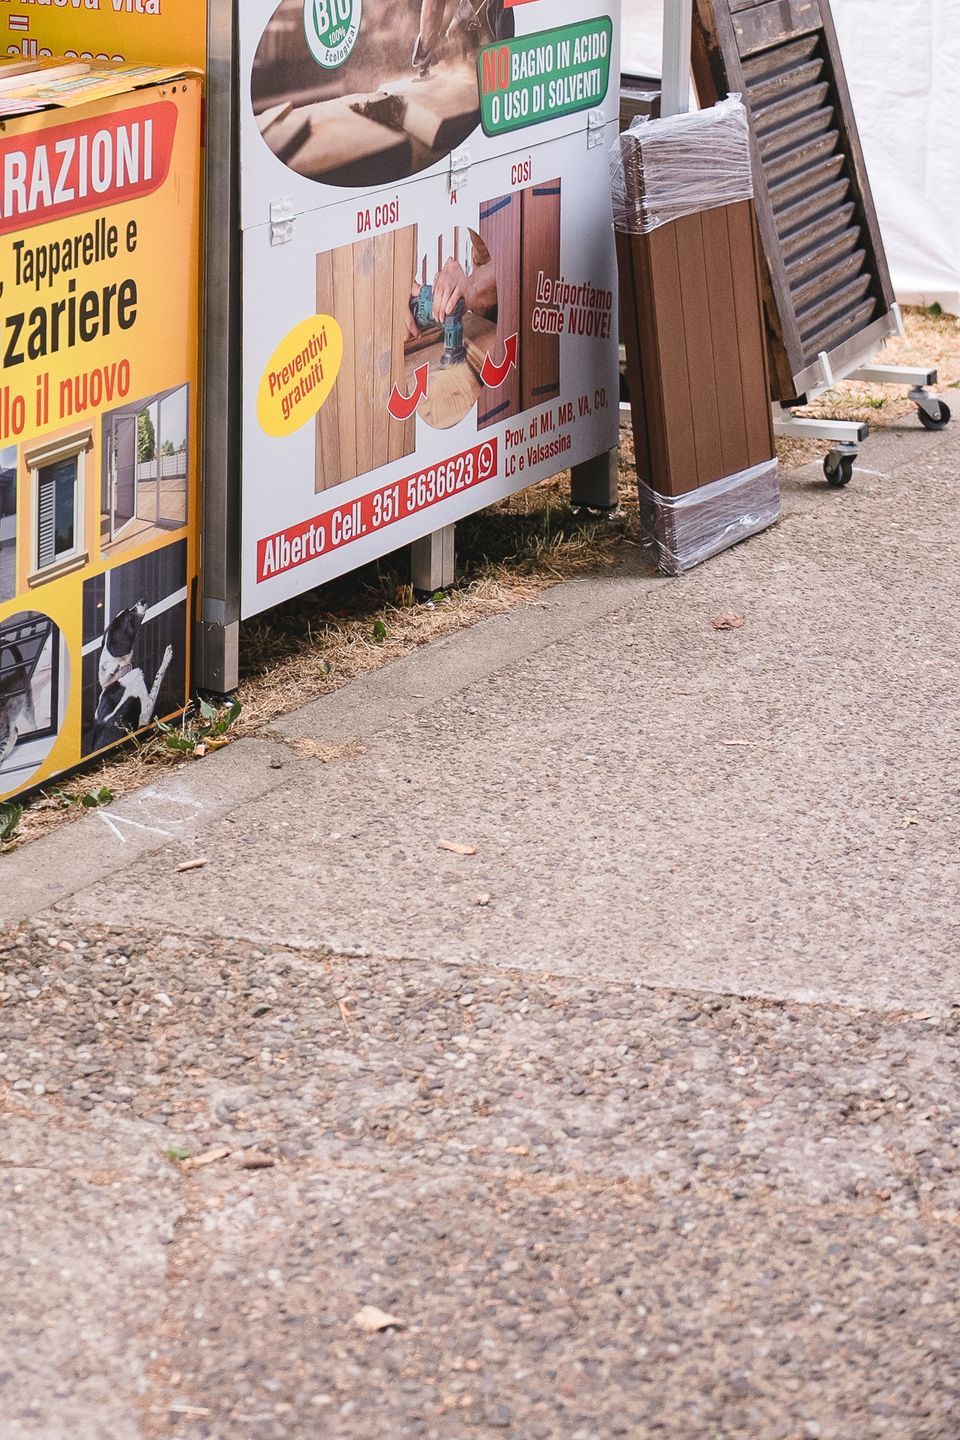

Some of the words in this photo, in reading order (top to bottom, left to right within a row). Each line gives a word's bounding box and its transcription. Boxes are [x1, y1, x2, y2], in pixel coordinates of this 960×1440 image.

[324, 24, 356, 62] Ecological
[328, 25, 346, 46] 100%
[482, 45, 510, 94] NO
[511, 44, 554, 82] BAGNO
[557, 40, 571, 70] IN
[573, 30, 607, 65] ACIDO
[491, 95, 500, 125] O
[504, 83, 529, 121] USO
[532, 82, 545, 112] DI
[548, 67, 601, 109] SOLVENTI
[356, 208, 371, 235] DA
[374, 195, 399, 229] COSÌ
[510, 156, 532, 186] COSÌ
[12, 217, 119, 291] Tapparelle
[126, 219, 138, 253] e
[536, 271, 551, 303] Le
[554, 277, 612, 310] riportiamo
[533, 306, 564, 334] come
[567, 307, 612, 338] NUOVE!
[268, 325, 328, 397] Preventivi
[281, 358, 324, 420] gratuiti
[36, 372, 49, 428] il
[59, 358, 130, 419] nuovo
[504, 427, 527, 450] Prov.
[530, 422, 538, 438] di
[540, 412, 556, 433] MI,
[558, 401, 576, 426] MB,
[578, 394, 592, 417] VA,
[594, 388, 609, 409] CO,
[504, 455, 516, 478] LC
[518, 456, 525, 470] e
[526, 433, 572, 468] Valsassina
[262, 523, 326, 577] Alberto
[331, 501, 367, 544] Cell.
[372, 486, 399, 527] 351
[406, 453, 474, 511] 5636623
